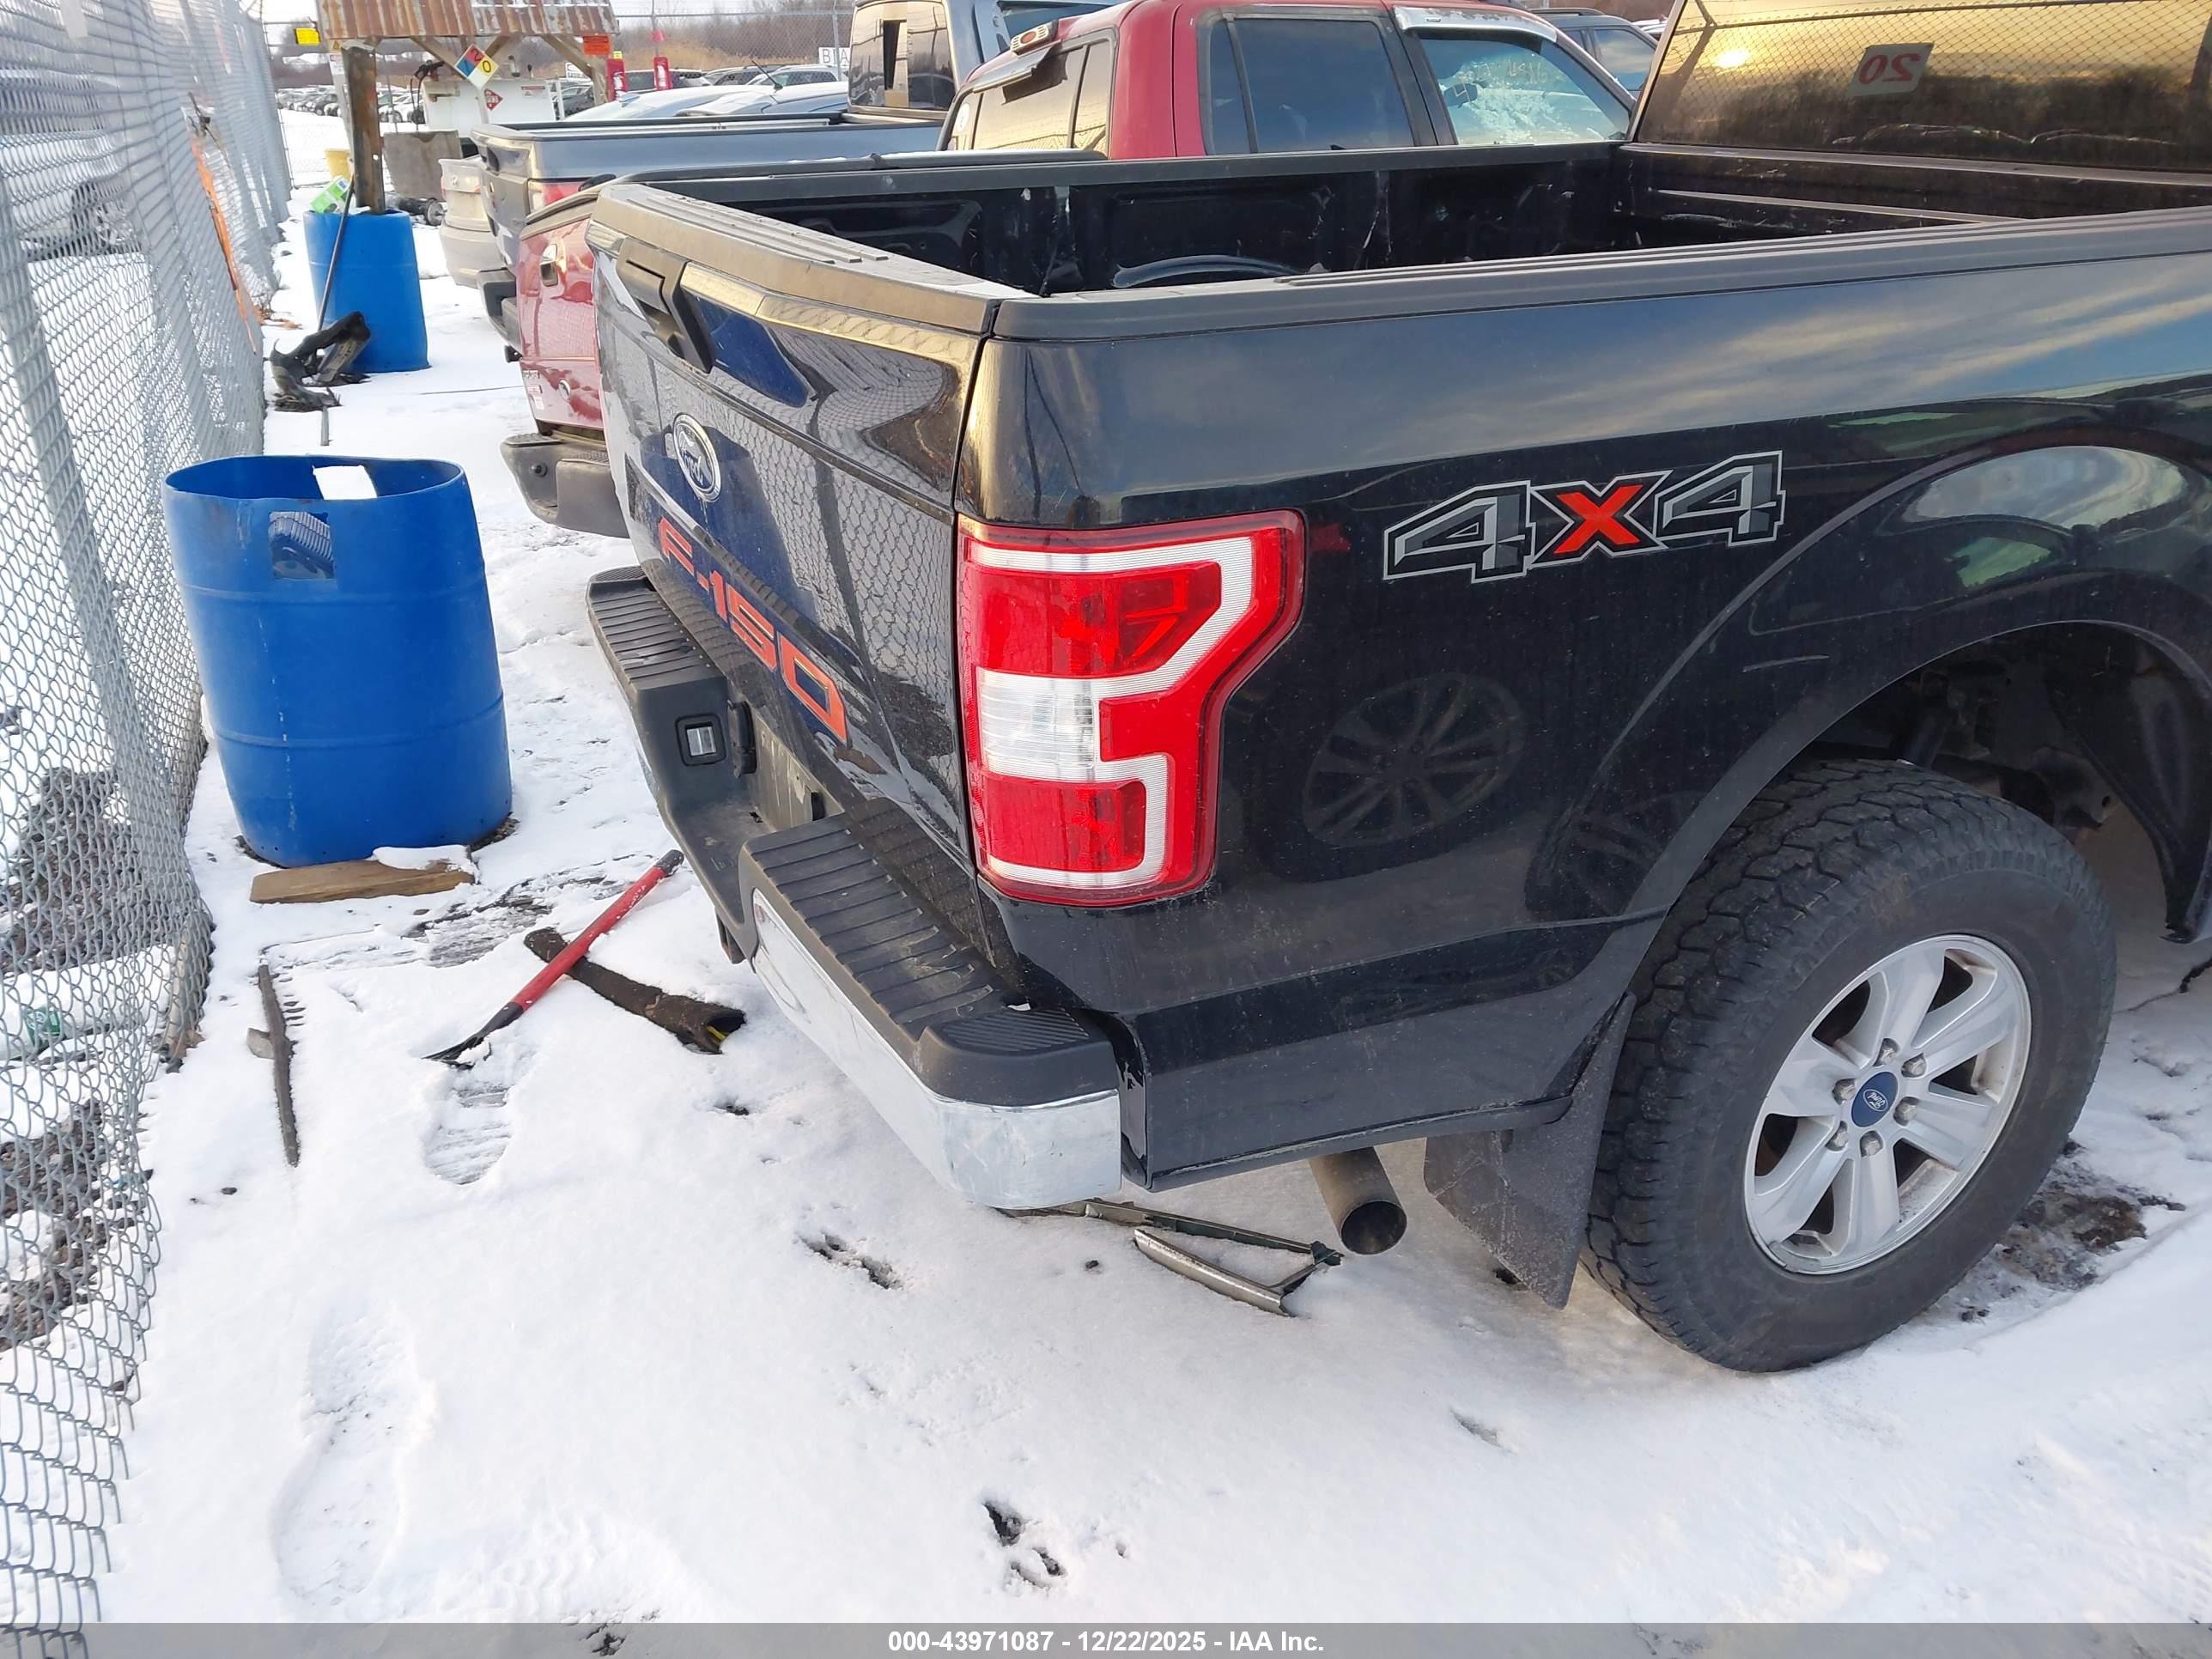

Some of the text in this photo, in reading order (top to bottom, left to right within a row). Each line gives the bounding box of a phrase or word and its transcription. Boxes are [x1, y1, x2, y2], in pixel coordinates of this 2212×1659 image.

[483, 60, 491, 73] 0
[678, 429, 705, 487] Ford
[658, 516, 848, 744] F-150
[1867, 1091, 1886, 1109] Ford
